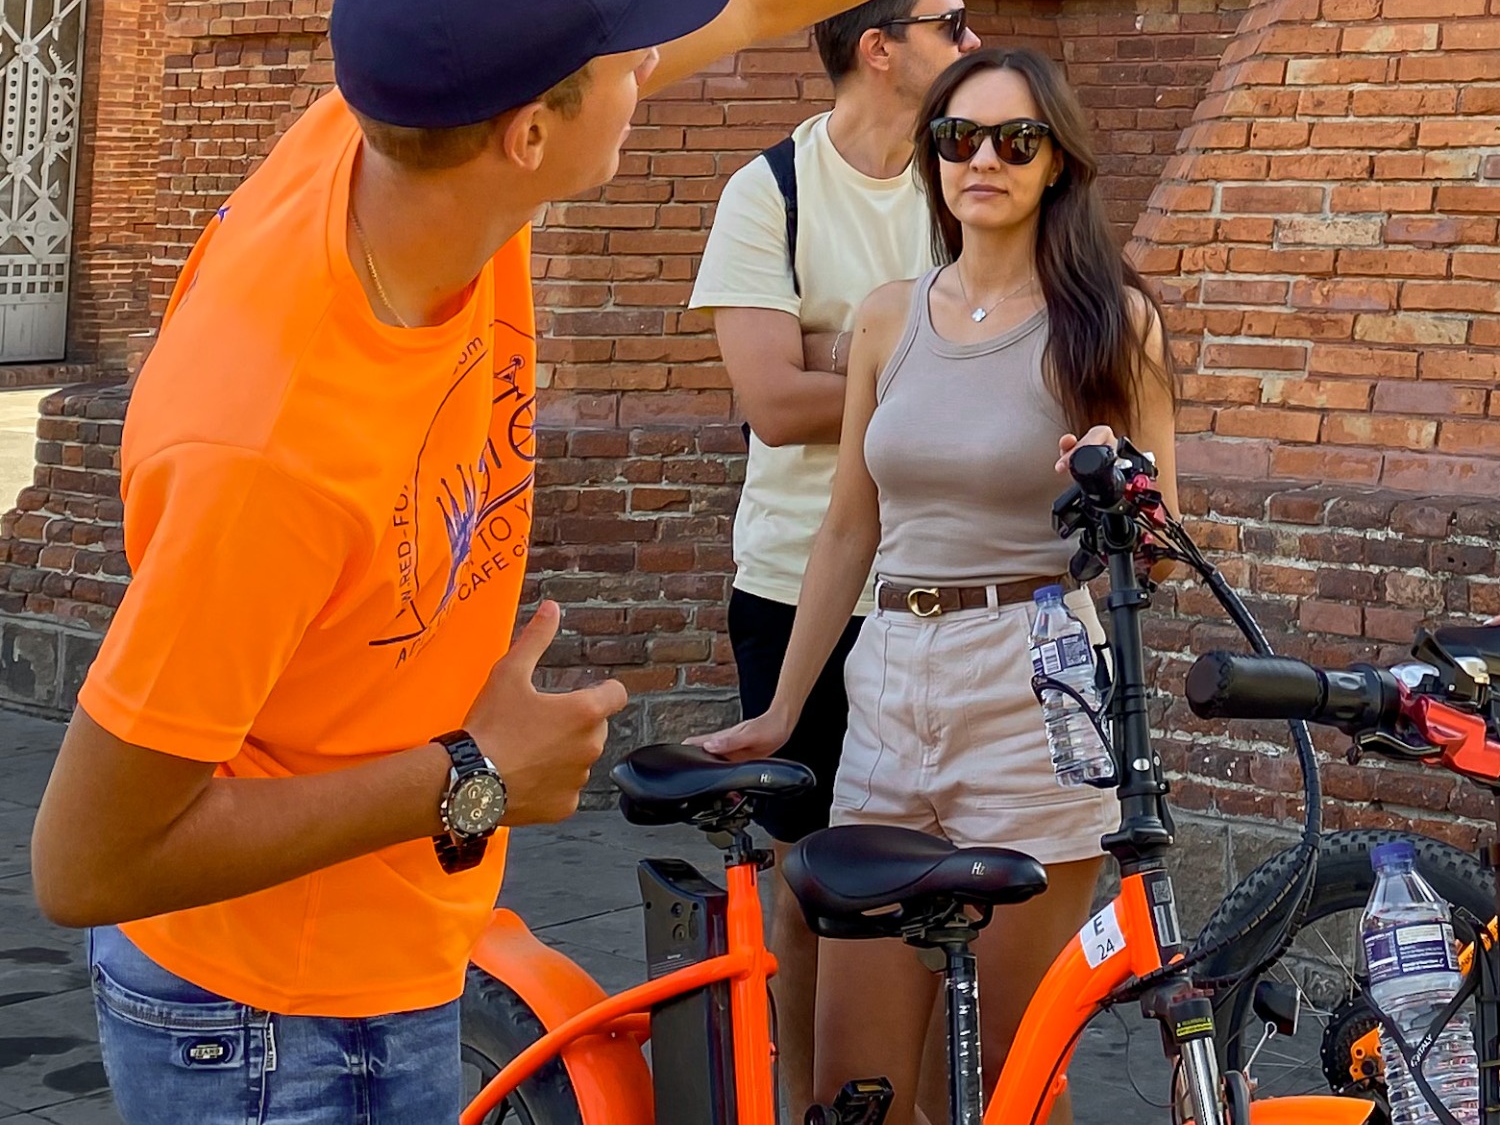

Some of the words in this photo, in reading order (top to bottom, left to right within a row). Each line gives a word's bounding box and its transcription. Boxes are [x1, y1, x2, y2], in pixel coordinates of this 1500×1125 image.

[476, 516, 512, 552] TO
[457, 552, 510, 601] CAFE
[1093, 915, 1105, 936] E
[1096, 938, 1115, 961] 24
